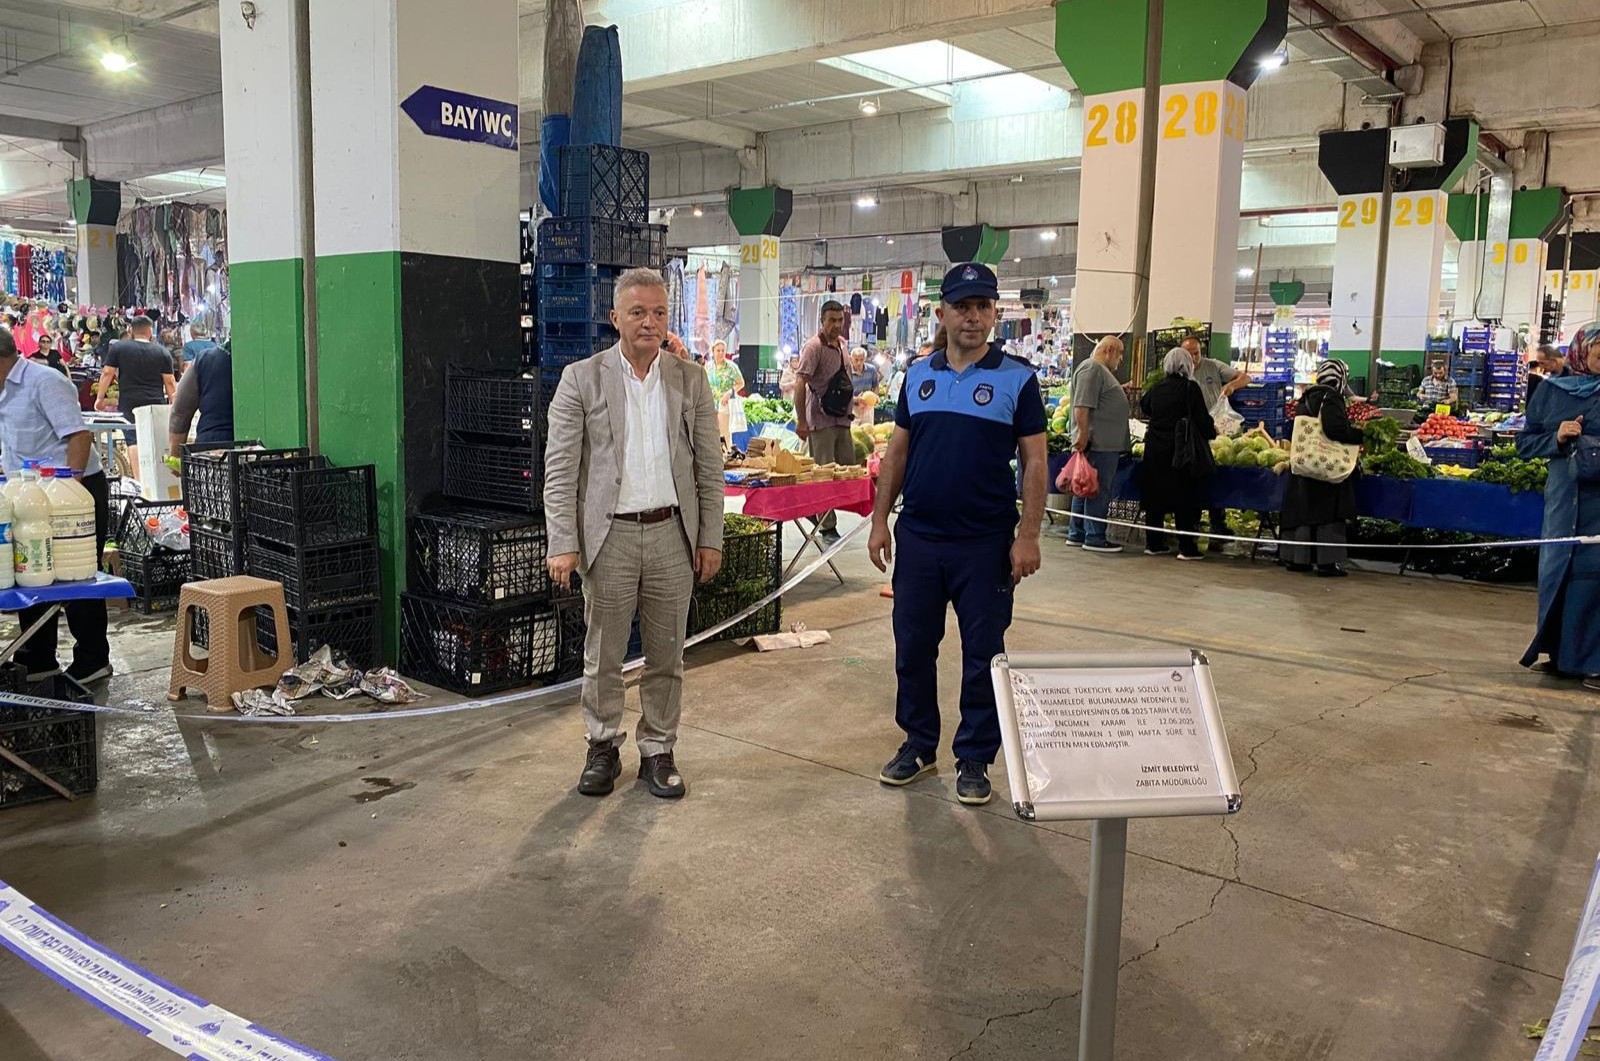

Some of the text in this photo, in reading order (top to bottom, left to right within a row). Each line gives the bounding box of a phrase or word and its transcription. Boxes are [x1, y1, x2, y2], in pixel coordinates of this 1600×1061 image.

[441, 101, 512, 137] BAY WC
[1086, 101, 1138, 147] 28
[1163, 91, 1218, 139] 28
[1340, 197, 1378, 227] 29
[1395, 196, 1434, 226] 29
[742, 244, 760, 264] 29
[762, 239, 778, 259] 29
[1492, 243, 1528, 265] 30
[1571, 274, 1594, 290] 31
[1041, 687, 1071, 695] YERİNDE
[1115, 686, 1134, 694] KARŞI
[1137, 685, 1159, 693] SÖZLÜ
[1088, 696, 1138, 704] BULUNULMASI
[1141, 695, 1177, 703] NEDENİYLE
[1060, 708, 1110, 716] BELEDİYESİNİN
[1170, 706, 1179, 714] VE
[1071, 729, 1103, 737] İTİBAREN
[1117, 729, 1134, 738] (BİR)
[1138, 728, 1161, 736] HAFTA
[1165, 728, 1183, 736] SÜRE
[1141, 763, 1200, 773] İZMİT BELEDİYESİ
[1136, 777, 1207, 787] ZABITA MÜDÜRLÜĞÜ
